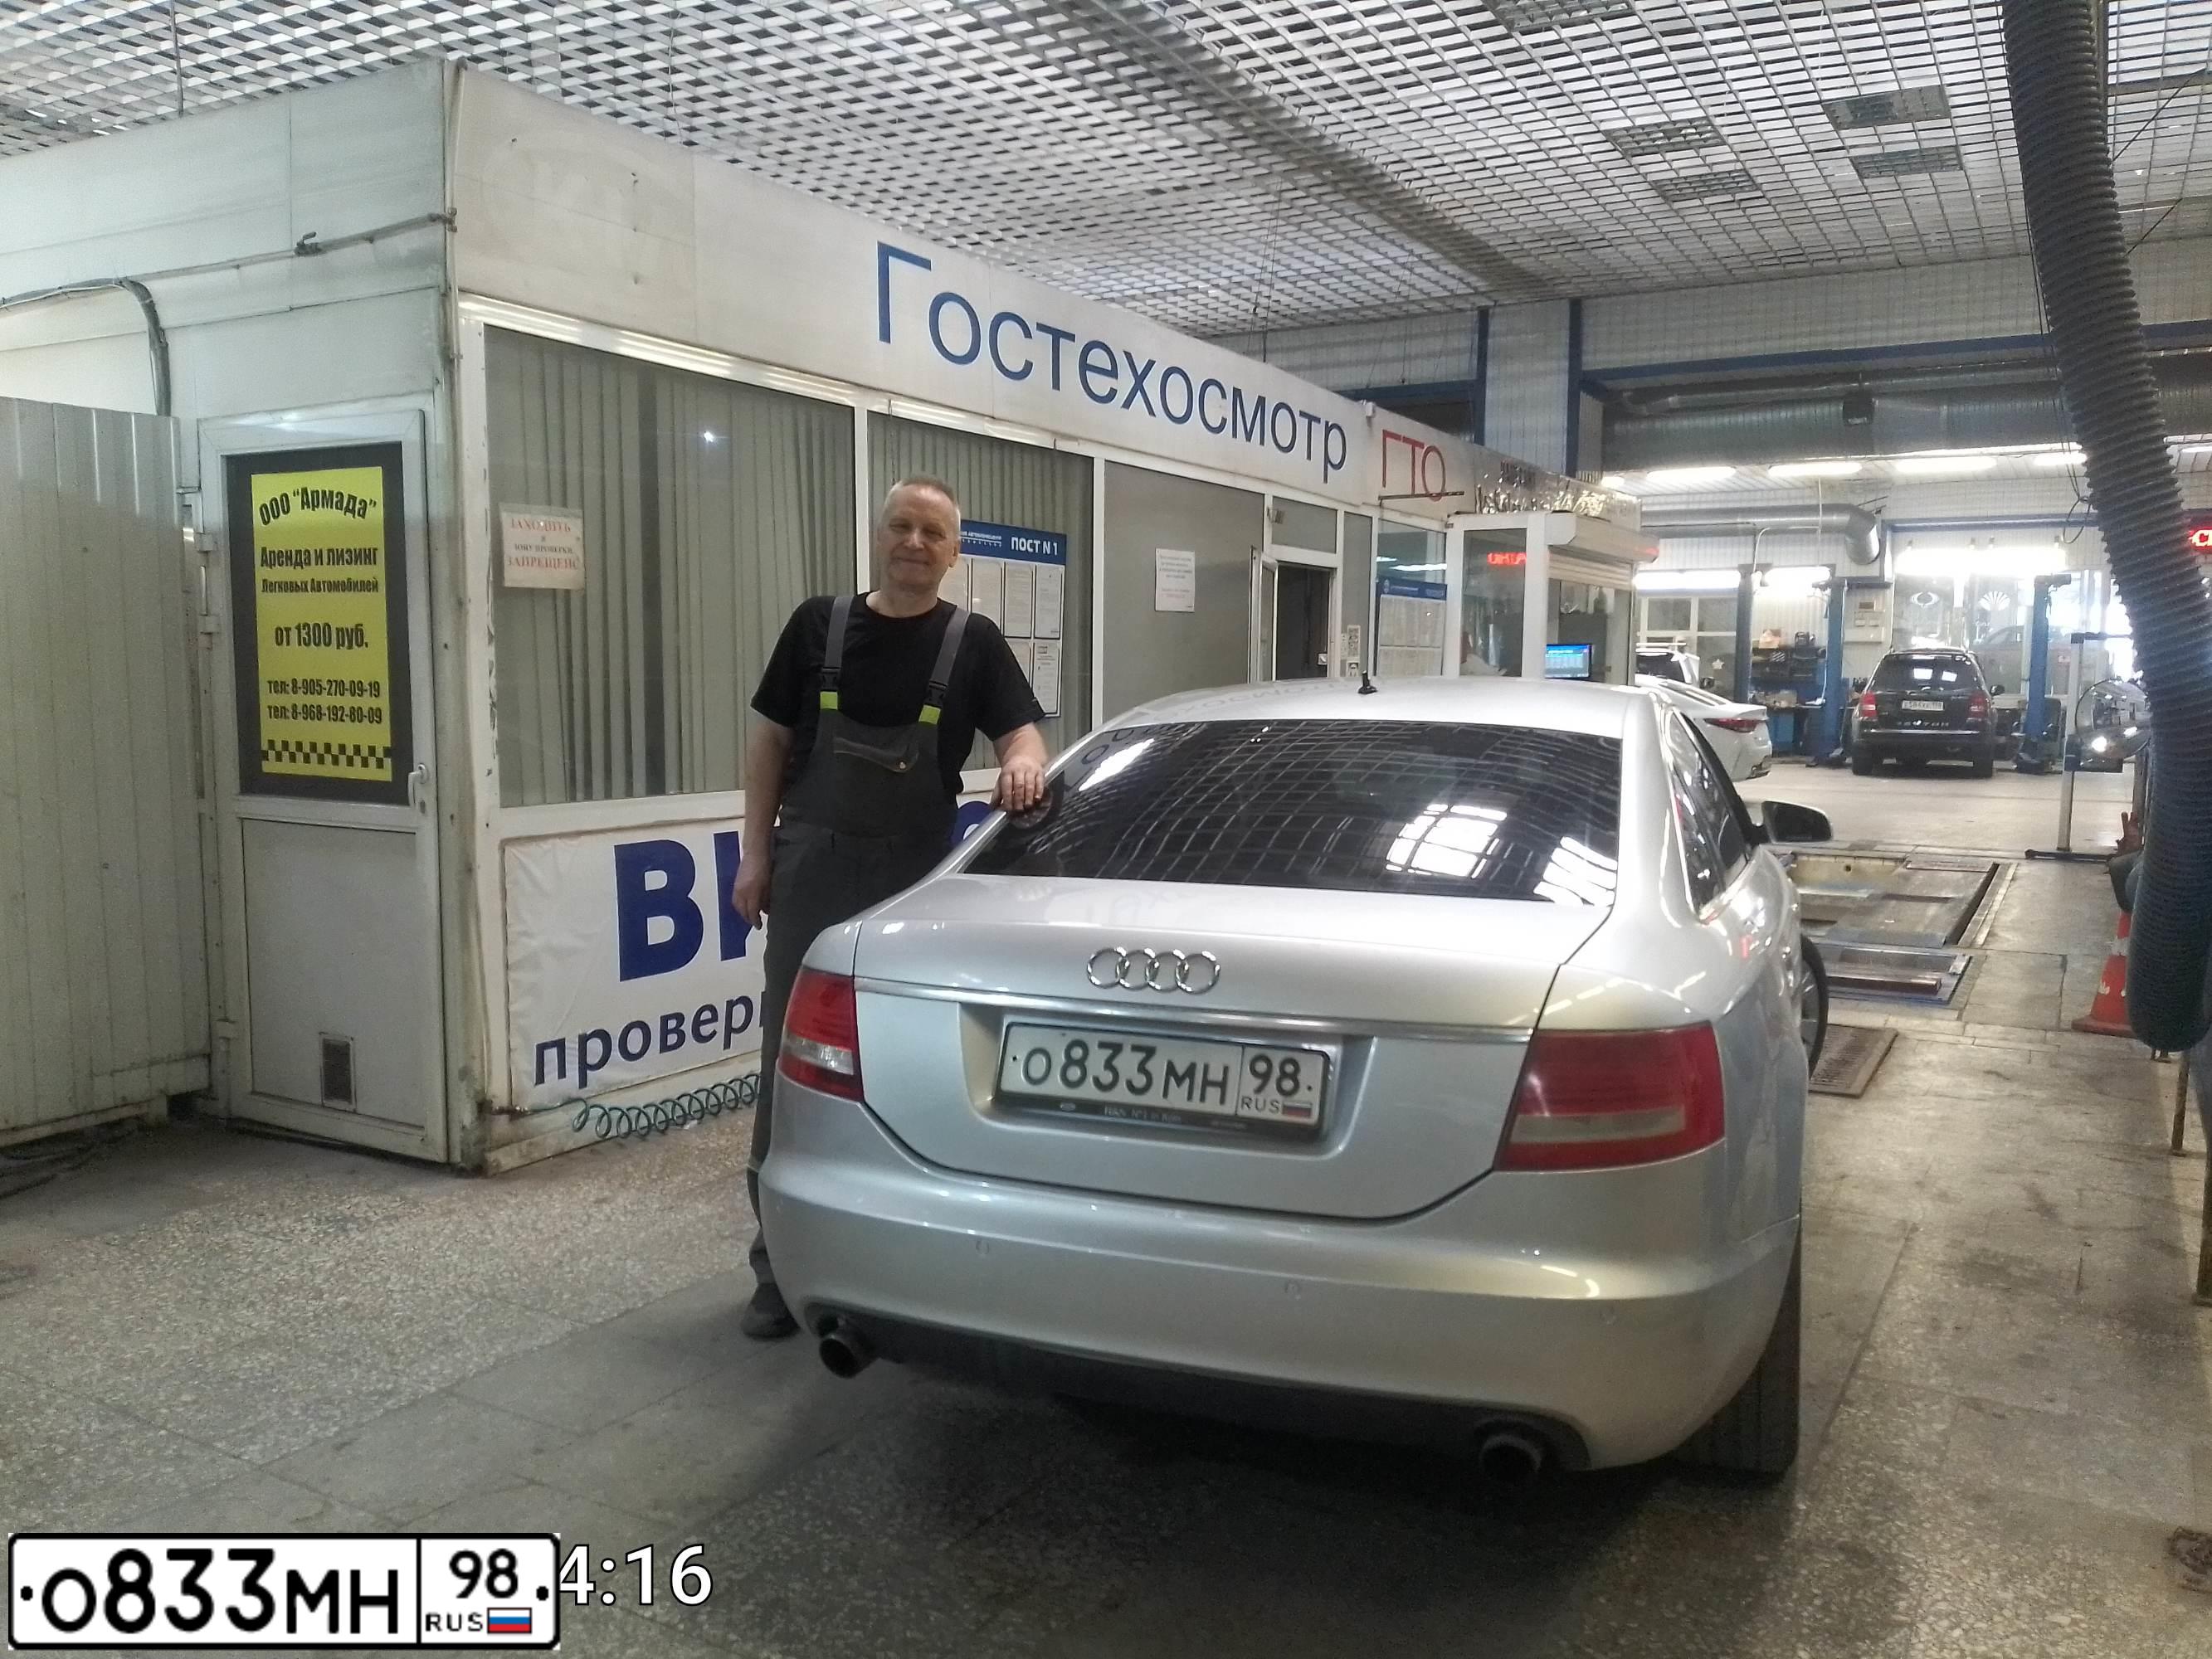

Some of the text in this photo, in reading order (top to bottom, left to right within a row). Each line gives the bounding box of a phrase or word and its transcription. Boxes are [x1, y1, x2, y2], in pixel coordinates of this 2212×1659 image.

[876, 241, 1347, 484] Гостехосмотр
[1382, 429, 1445, 502] ГТО
[259, 492, 290, 526] ООО
[261, 547, 311, 569] Аренда
[327, 547, 378, 566] лизинг
[1011, 536, 1040, 553] ПОСТ
[1053, 542, 1058, 556] 1
[261, 577, 378, 593] Легковых Автомобилей
[275, 622, 368, 649] от 1300 руб.
[291, 678, 381, 698] 8-905-270-09-19
[534, 994, 765, 1089] провер
[1249, 1053, 1302, 1097] 98
[1241, 1095, 1280, 1115] RUS
